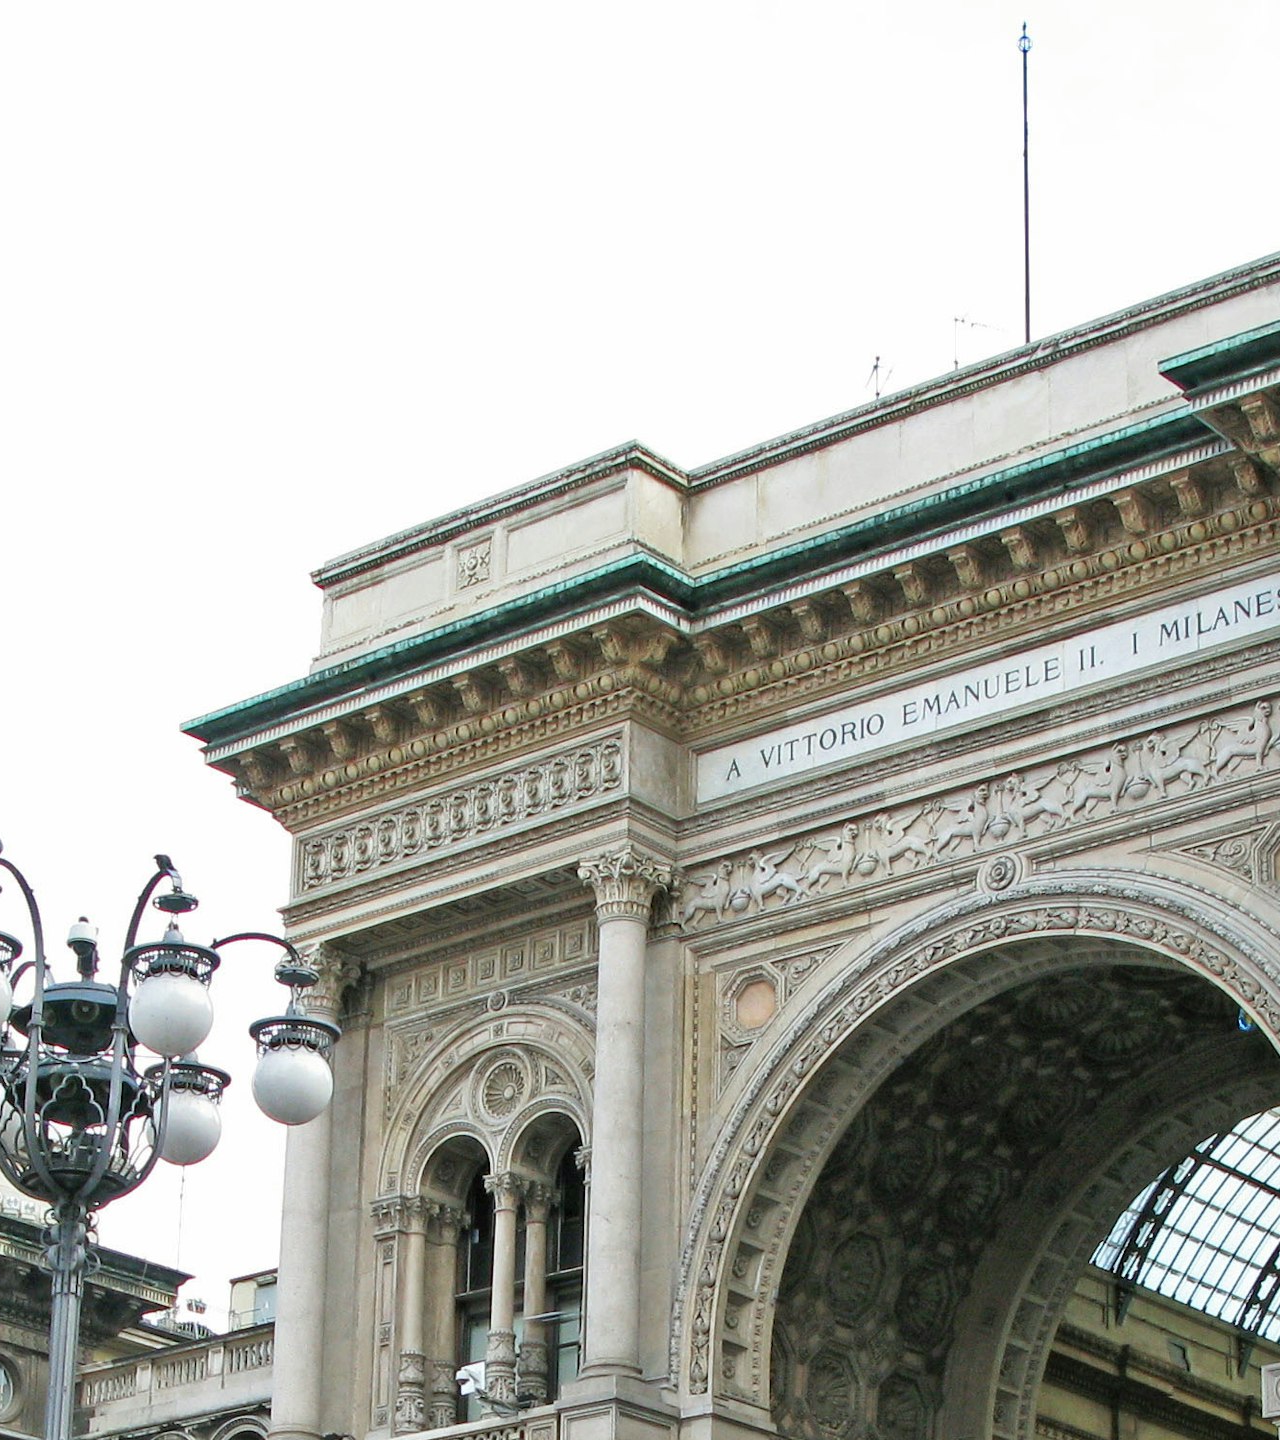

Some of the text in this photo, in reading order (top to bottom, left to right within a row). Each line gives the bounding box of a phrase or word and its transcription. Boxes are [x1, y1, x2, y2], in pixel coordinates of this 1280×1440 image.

[726, 758, 741, 781] A
[760, 713, 885, 768] VITTORIO
[901, 657, 1062, 727] EMANUELE
[1131, 632, 1138, 655] I
